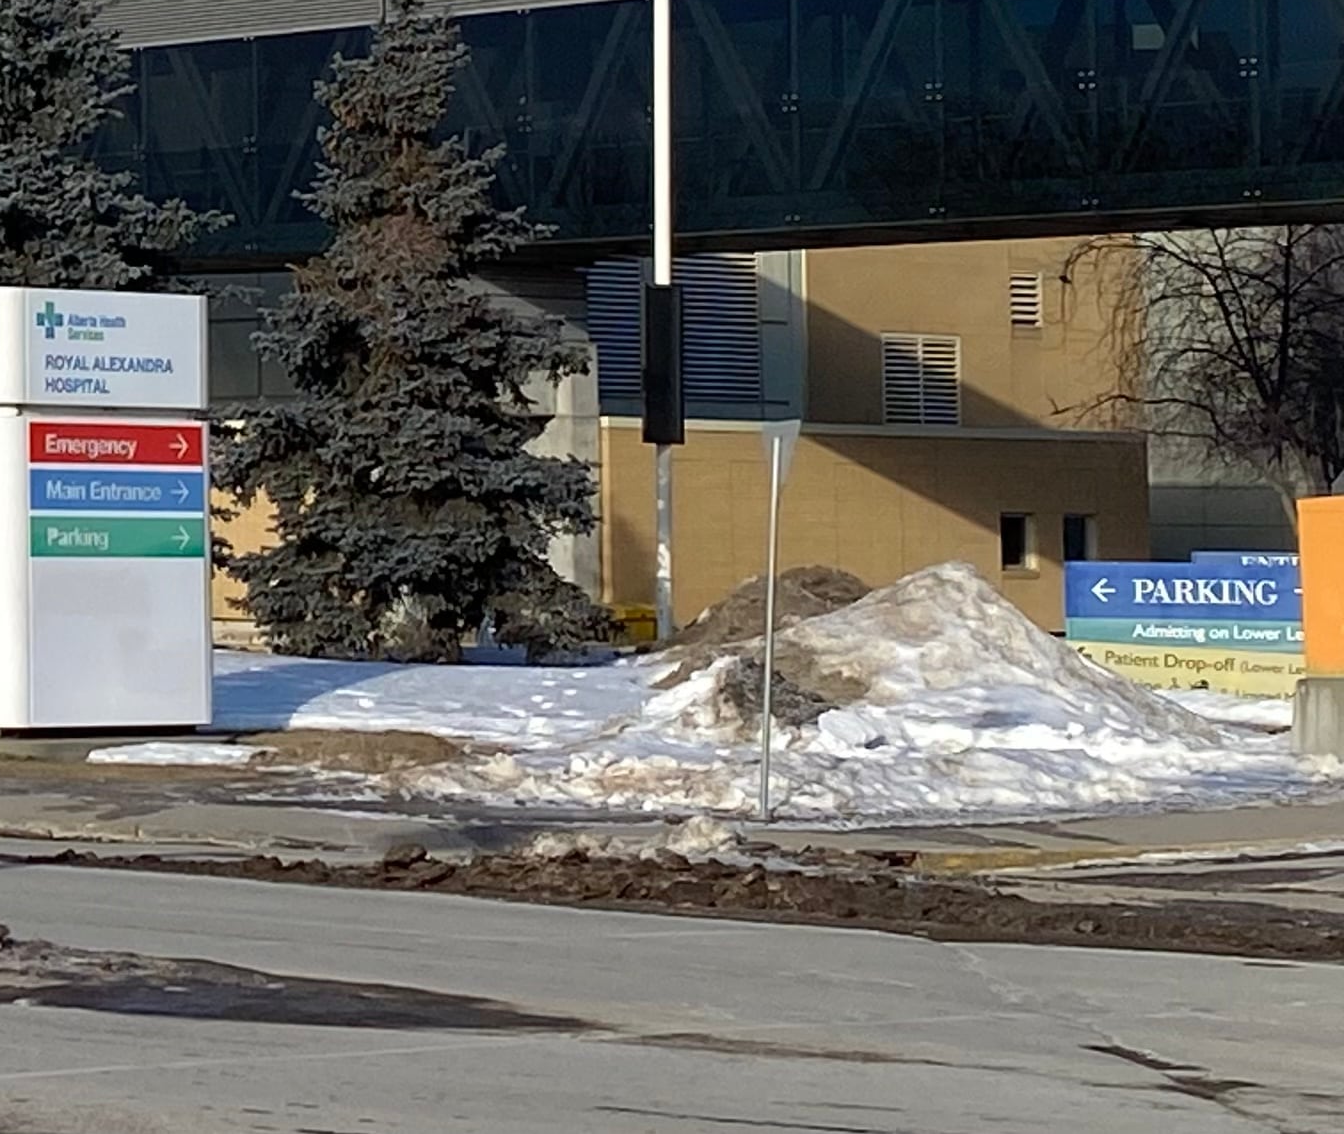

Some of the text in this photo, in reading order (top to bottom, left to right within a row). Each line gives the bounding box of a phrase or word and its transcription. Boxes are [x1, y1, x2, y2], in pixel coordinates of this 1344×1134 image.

[67, 313, 126, 328] Alberta Health
[67, 327, 104, 341] Services
[44, 354, 173, 374] ROYAL ALEXANDRA
[44, 377, 110, 394] HOSPITAL
[44, 433, 138, 459] Emergency
[45, 480, 162, 501] Main Entrance
[47, 526, 109, 554] Parking
[1132, 579, 1279, 605] PARKING
[1132, 624, 1305, 642] Admitting on Lower Le
[1104, 650, 1160, 667] Patient
[1164, 653, 1236, 673] Drop-off
[1240, 661, 1285, 674] (Lower
